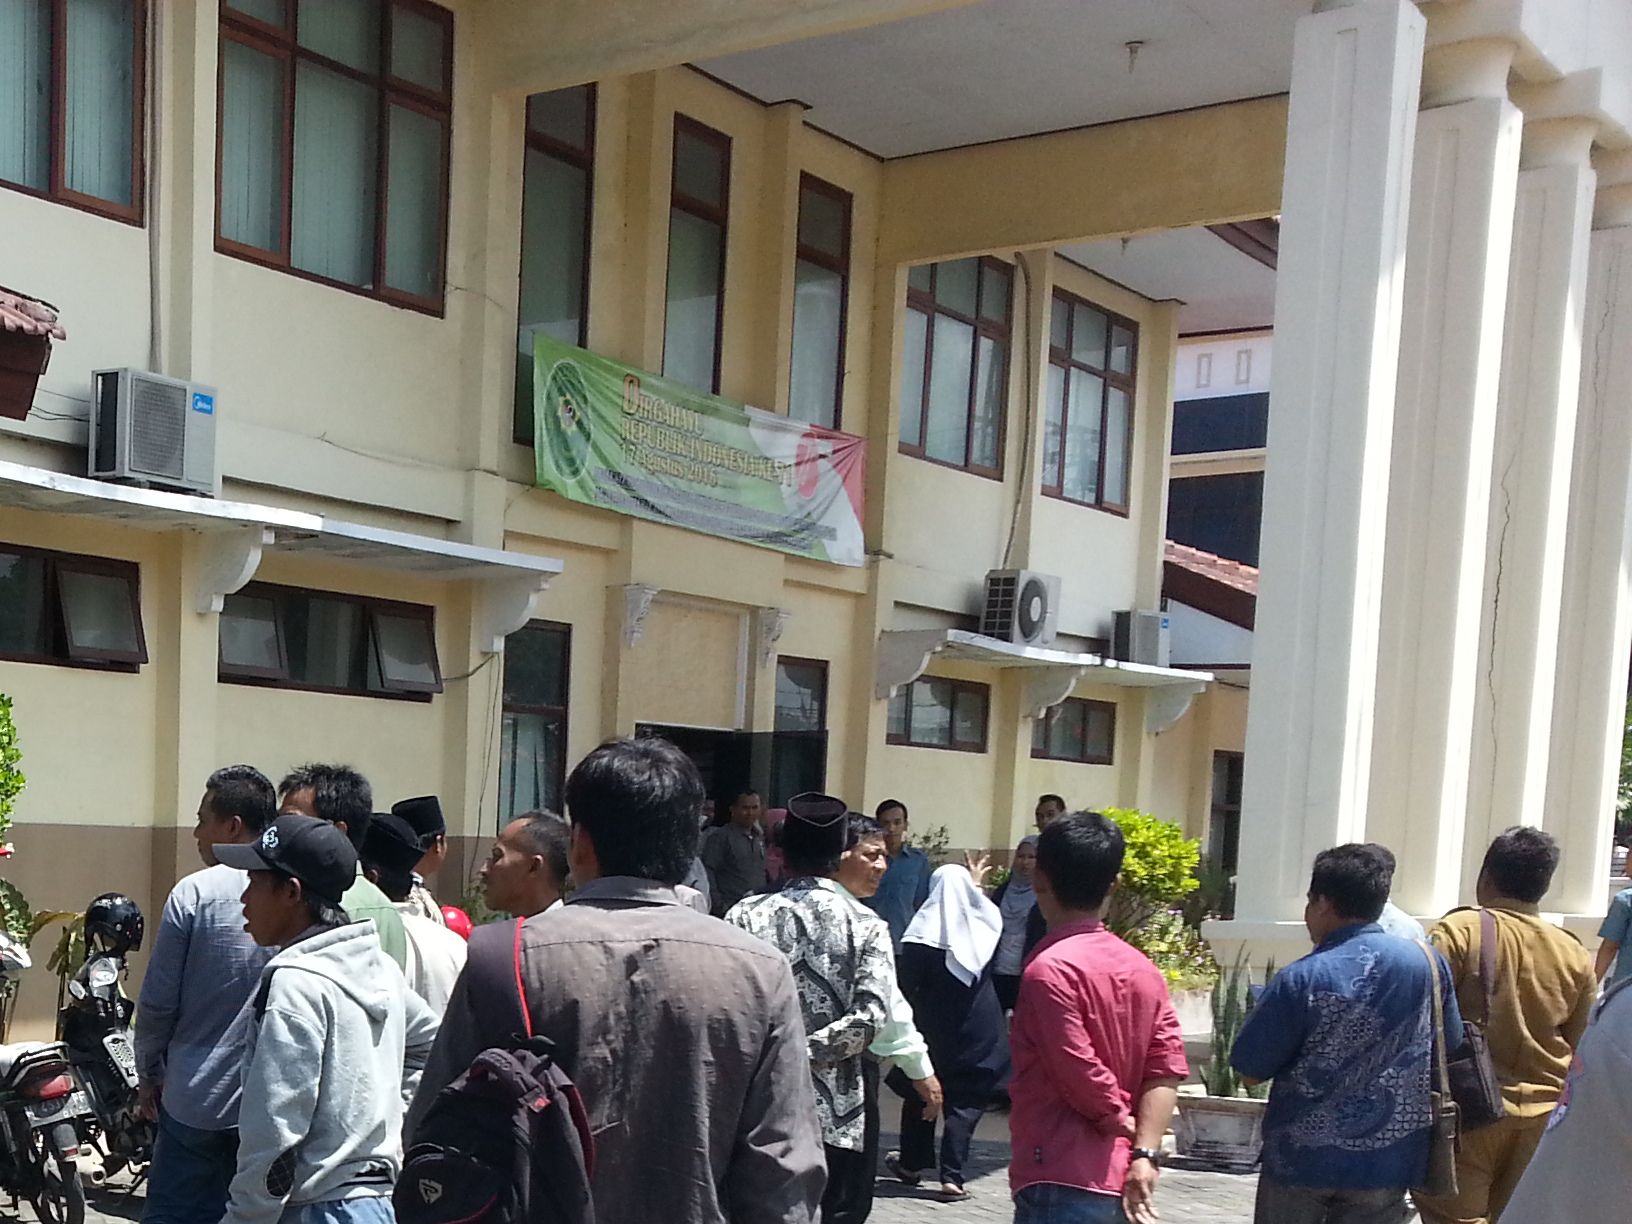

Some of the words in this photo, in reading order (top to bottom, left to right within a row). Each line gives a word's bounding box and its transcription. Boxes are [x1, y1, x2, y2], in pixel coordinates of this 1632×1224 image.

[622, 373, 704, 437] DIRGAHAYU
[621, 415, 686, 456] REPUBLIK
[622, 441, 636, 467] 17
[639, 448, 686, 480] Agustus
[687, 461, 719, 488] 2016
